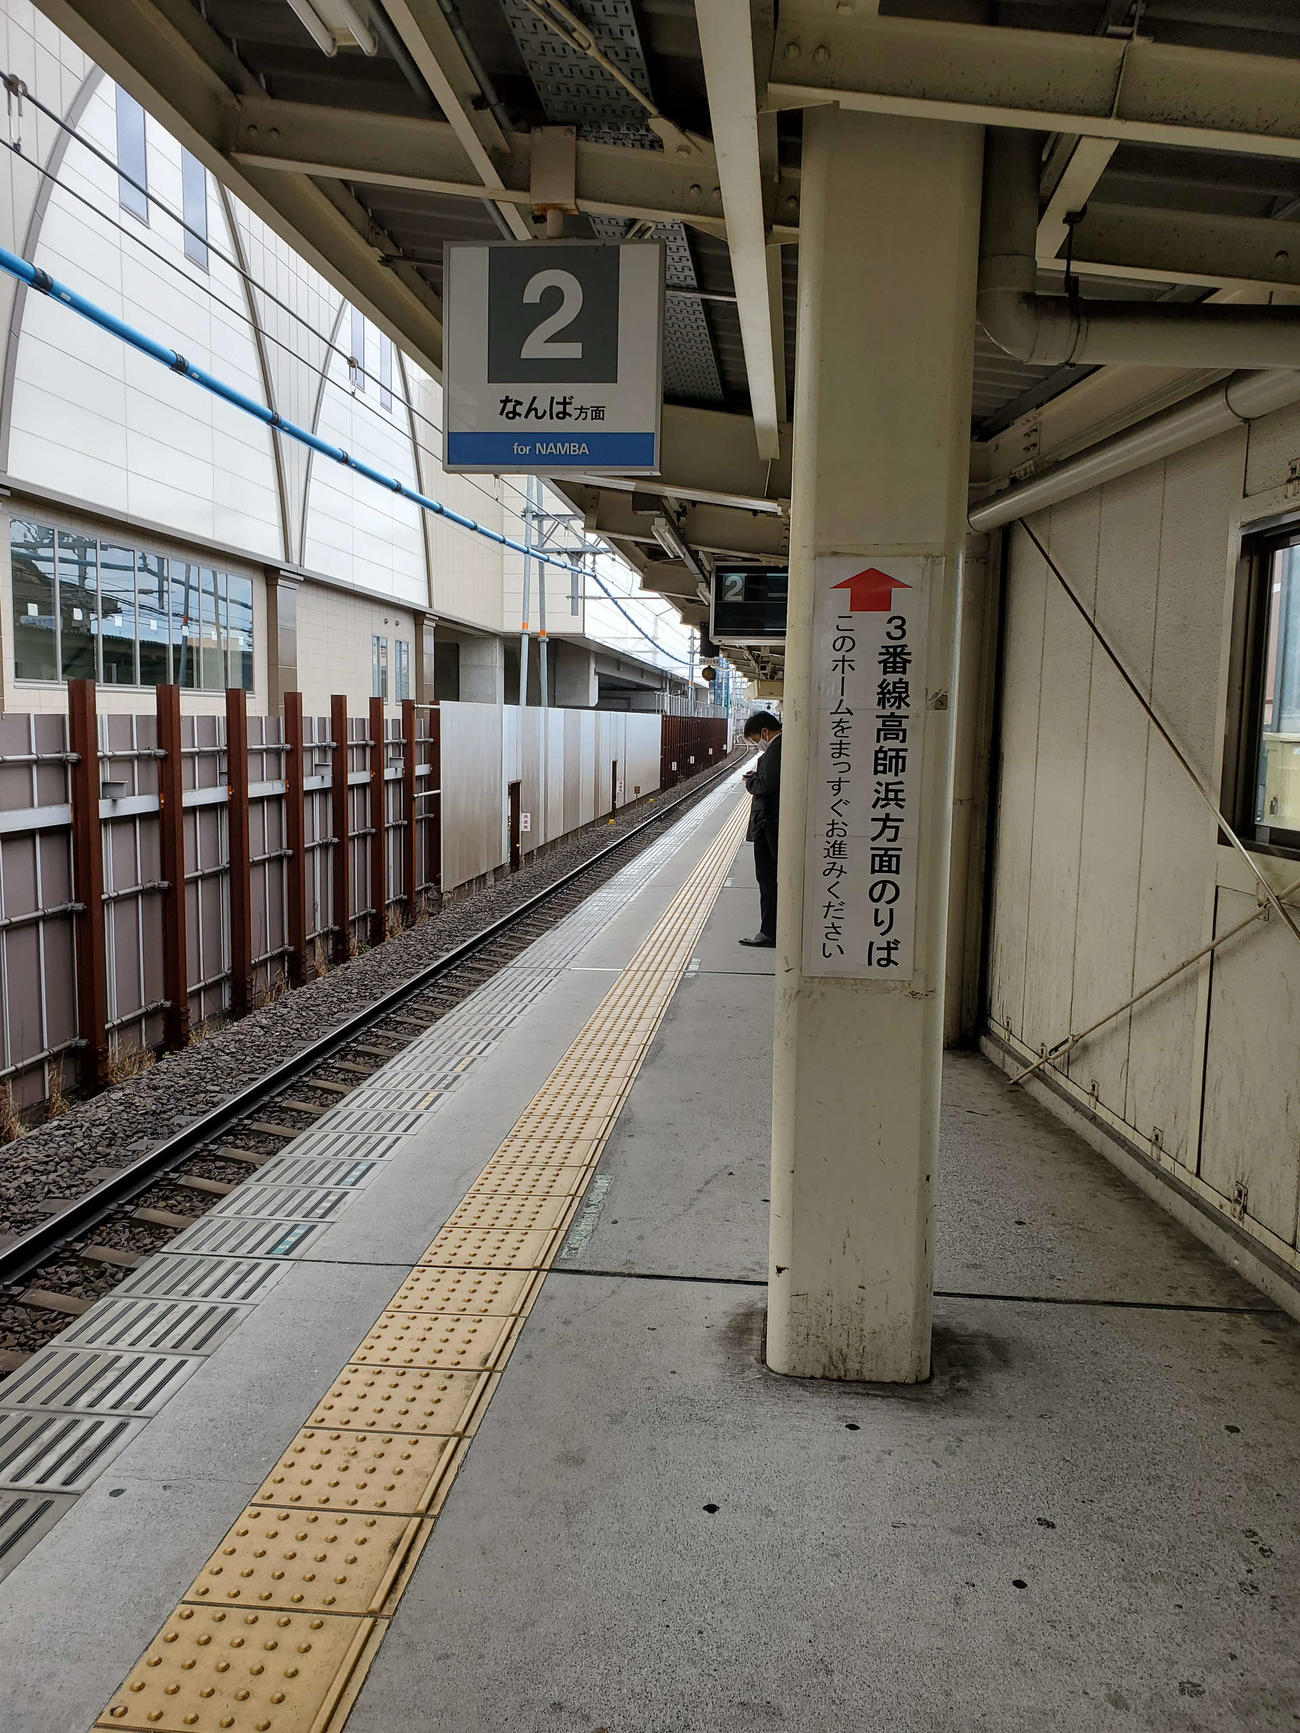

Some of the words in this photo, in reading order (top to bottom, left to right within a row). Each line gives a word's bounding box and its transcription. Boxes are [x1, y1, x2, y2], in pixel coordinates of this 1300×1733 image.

[520, 269, 583, 359] 2
[499, 395, 606, 421] なんば方面
[513, 442, 531, 455] for
[535, 442, 589, 455] NAMBA
[724, 575, 744, 600] 2
[822, 615, 856, 959] このホームをまっすぐお進みください
[867, 615, 912, 968] 3番線高師浜方面のりば
